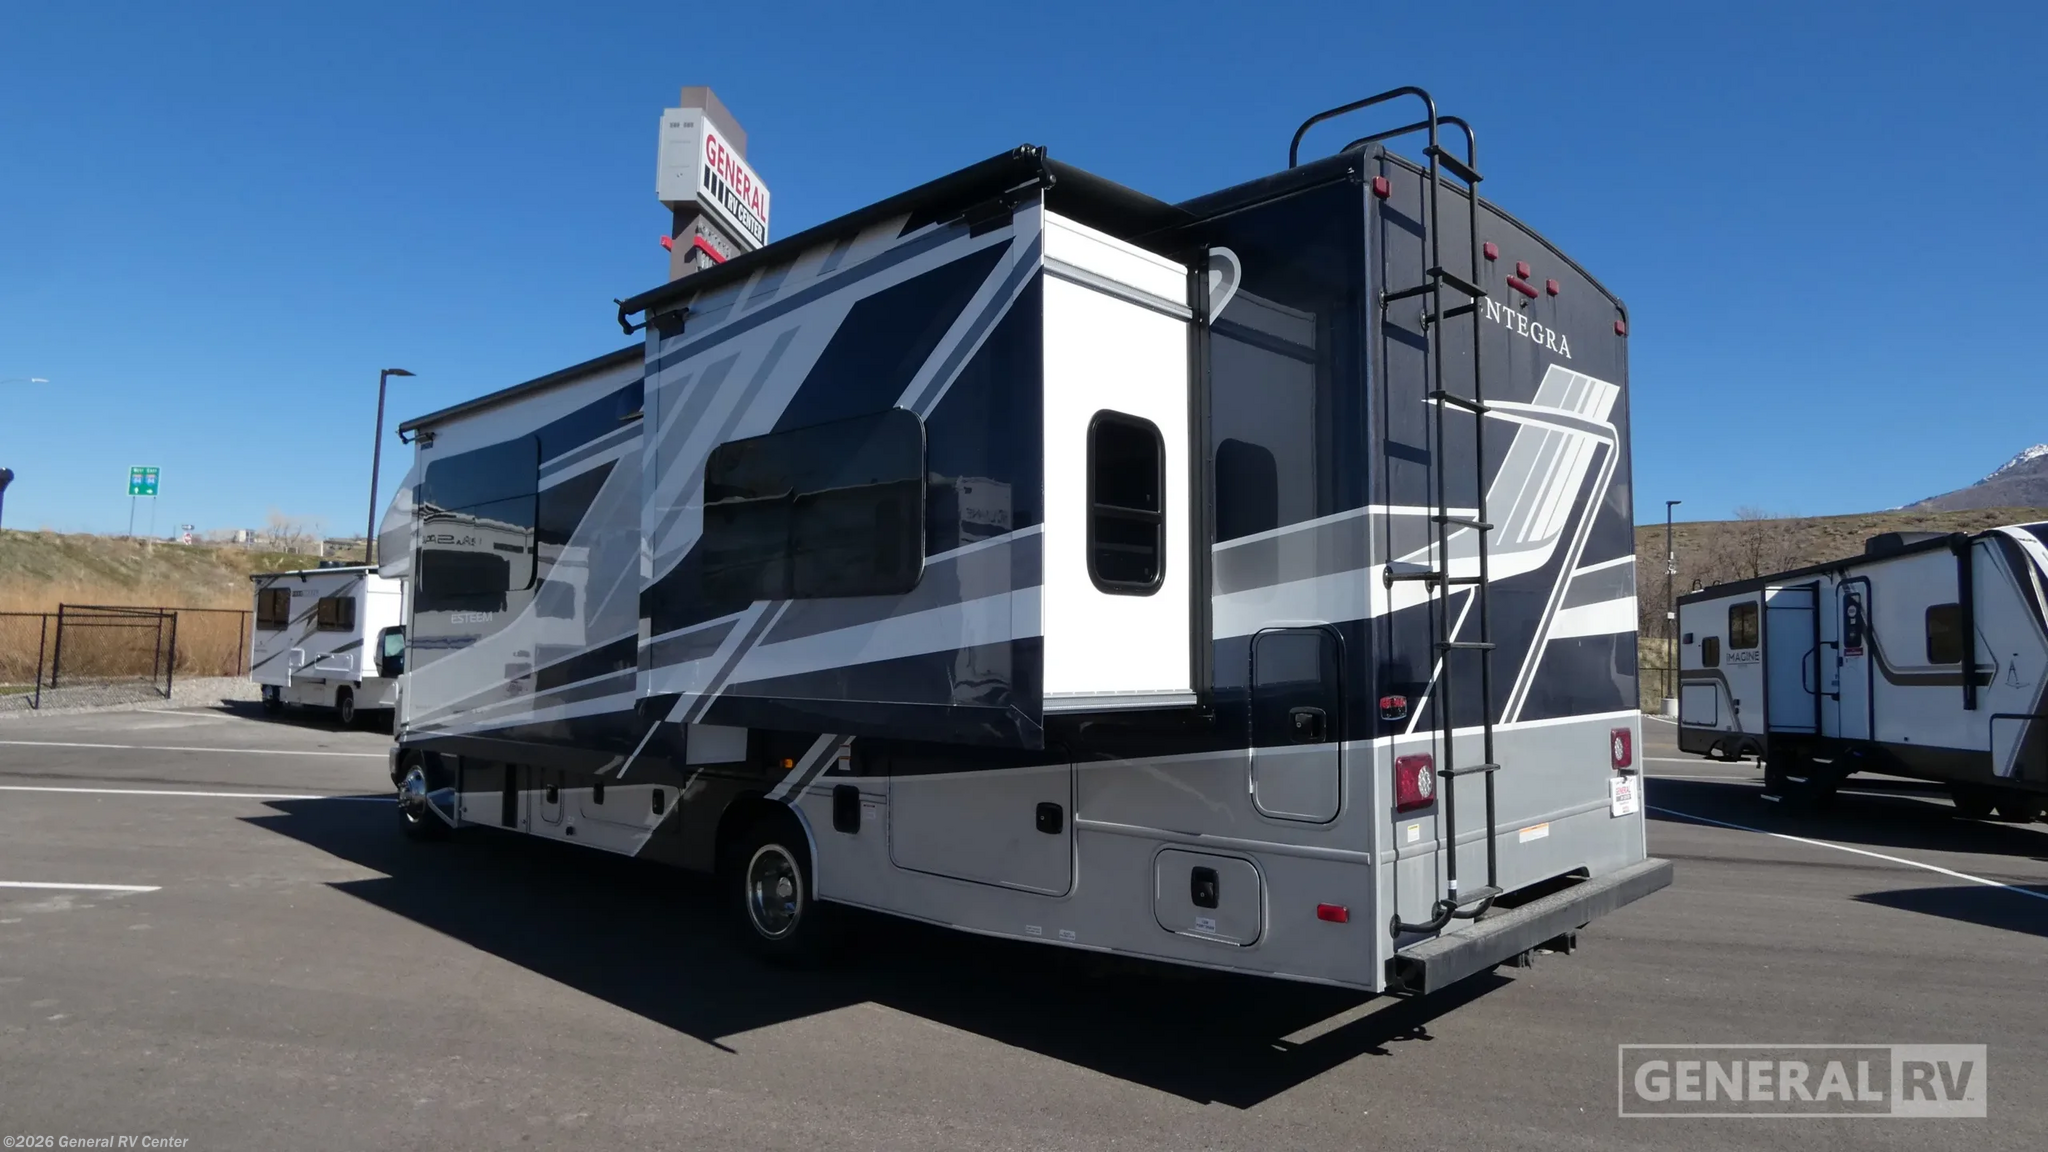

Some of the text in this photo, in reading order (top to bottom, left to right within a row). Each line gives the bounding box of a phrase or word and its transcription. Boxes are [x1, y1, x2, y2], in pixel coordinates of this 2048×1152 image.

[706, 134, 766, 223] GENERAL
[727, 192, 763, 242] RV CENTER
[1471, 296, 1572, 359] NTEGRA
[451, 611, 493, 624] ESTEEM
[1726, 651, 1760, 662] IMAGINE
